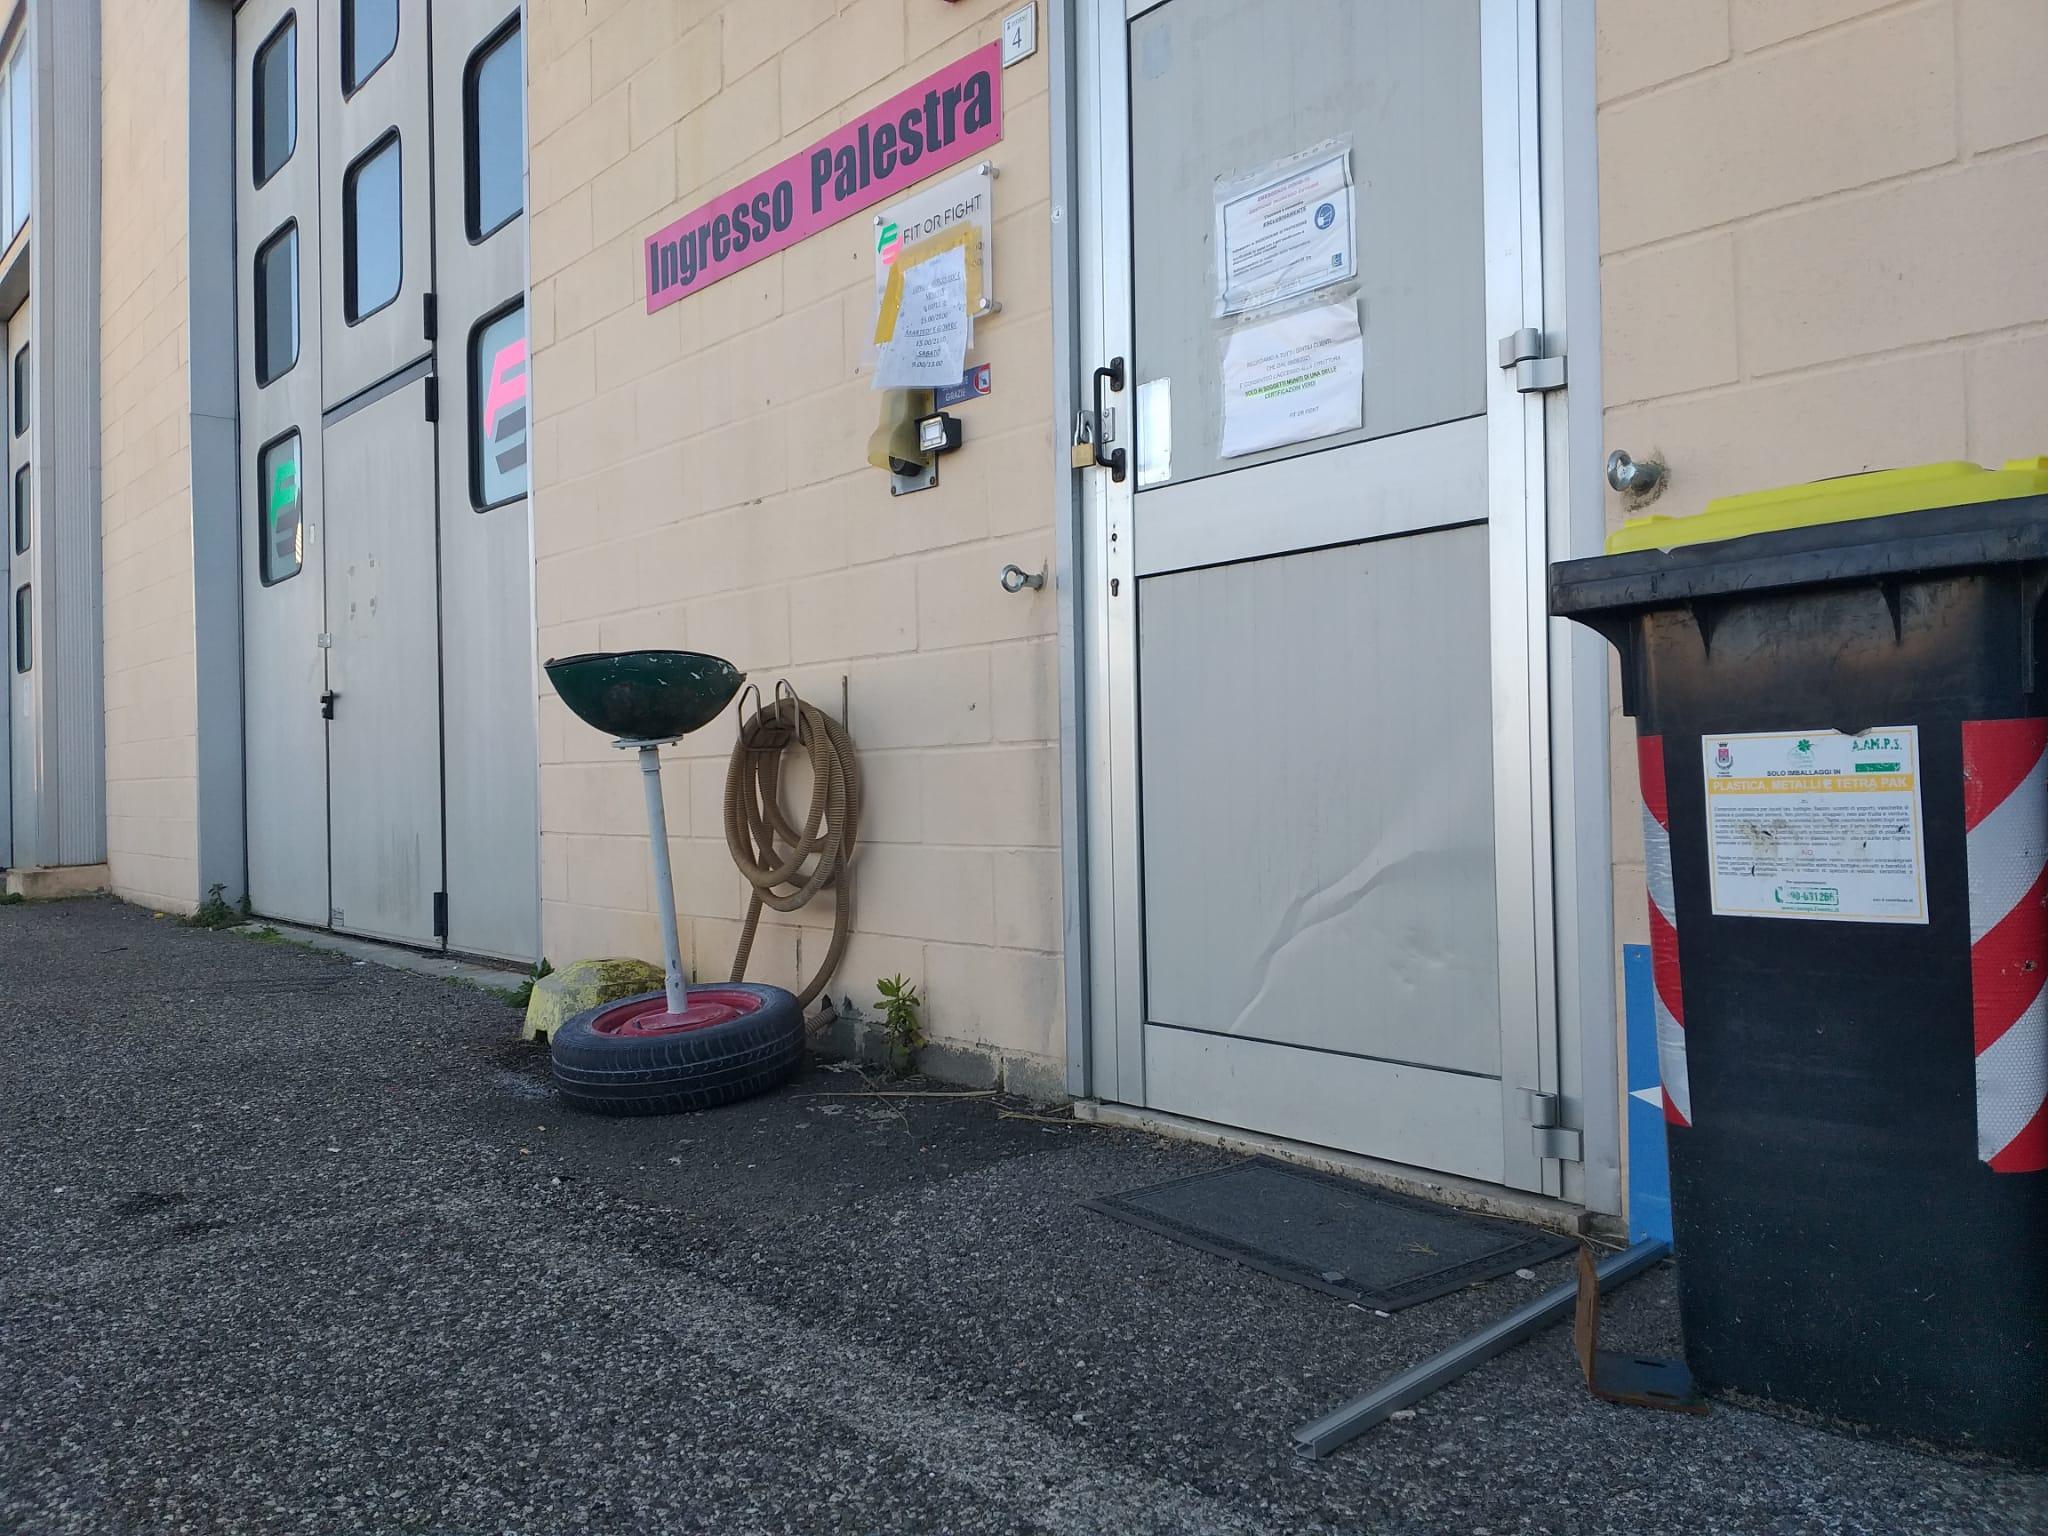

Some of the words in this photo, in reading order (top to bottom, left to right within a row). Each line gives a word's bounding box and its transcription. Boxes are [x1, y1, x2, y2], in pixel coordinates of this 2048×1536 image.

[1012, 26, 1022, 48] 4
[650, 179, 793, 295] Ingresso
[811, 70, 993, 214] Palestra
[903, 223, 921, 244] FIT
[924, 214, 941, 234] OR
[944, 193, 981, 224] FIGHT
[945, 391, 966, 401] GRAZIE
[1836, 778, 1875, 788] TETRA
[1881, 777, 1907, 787] PAK
